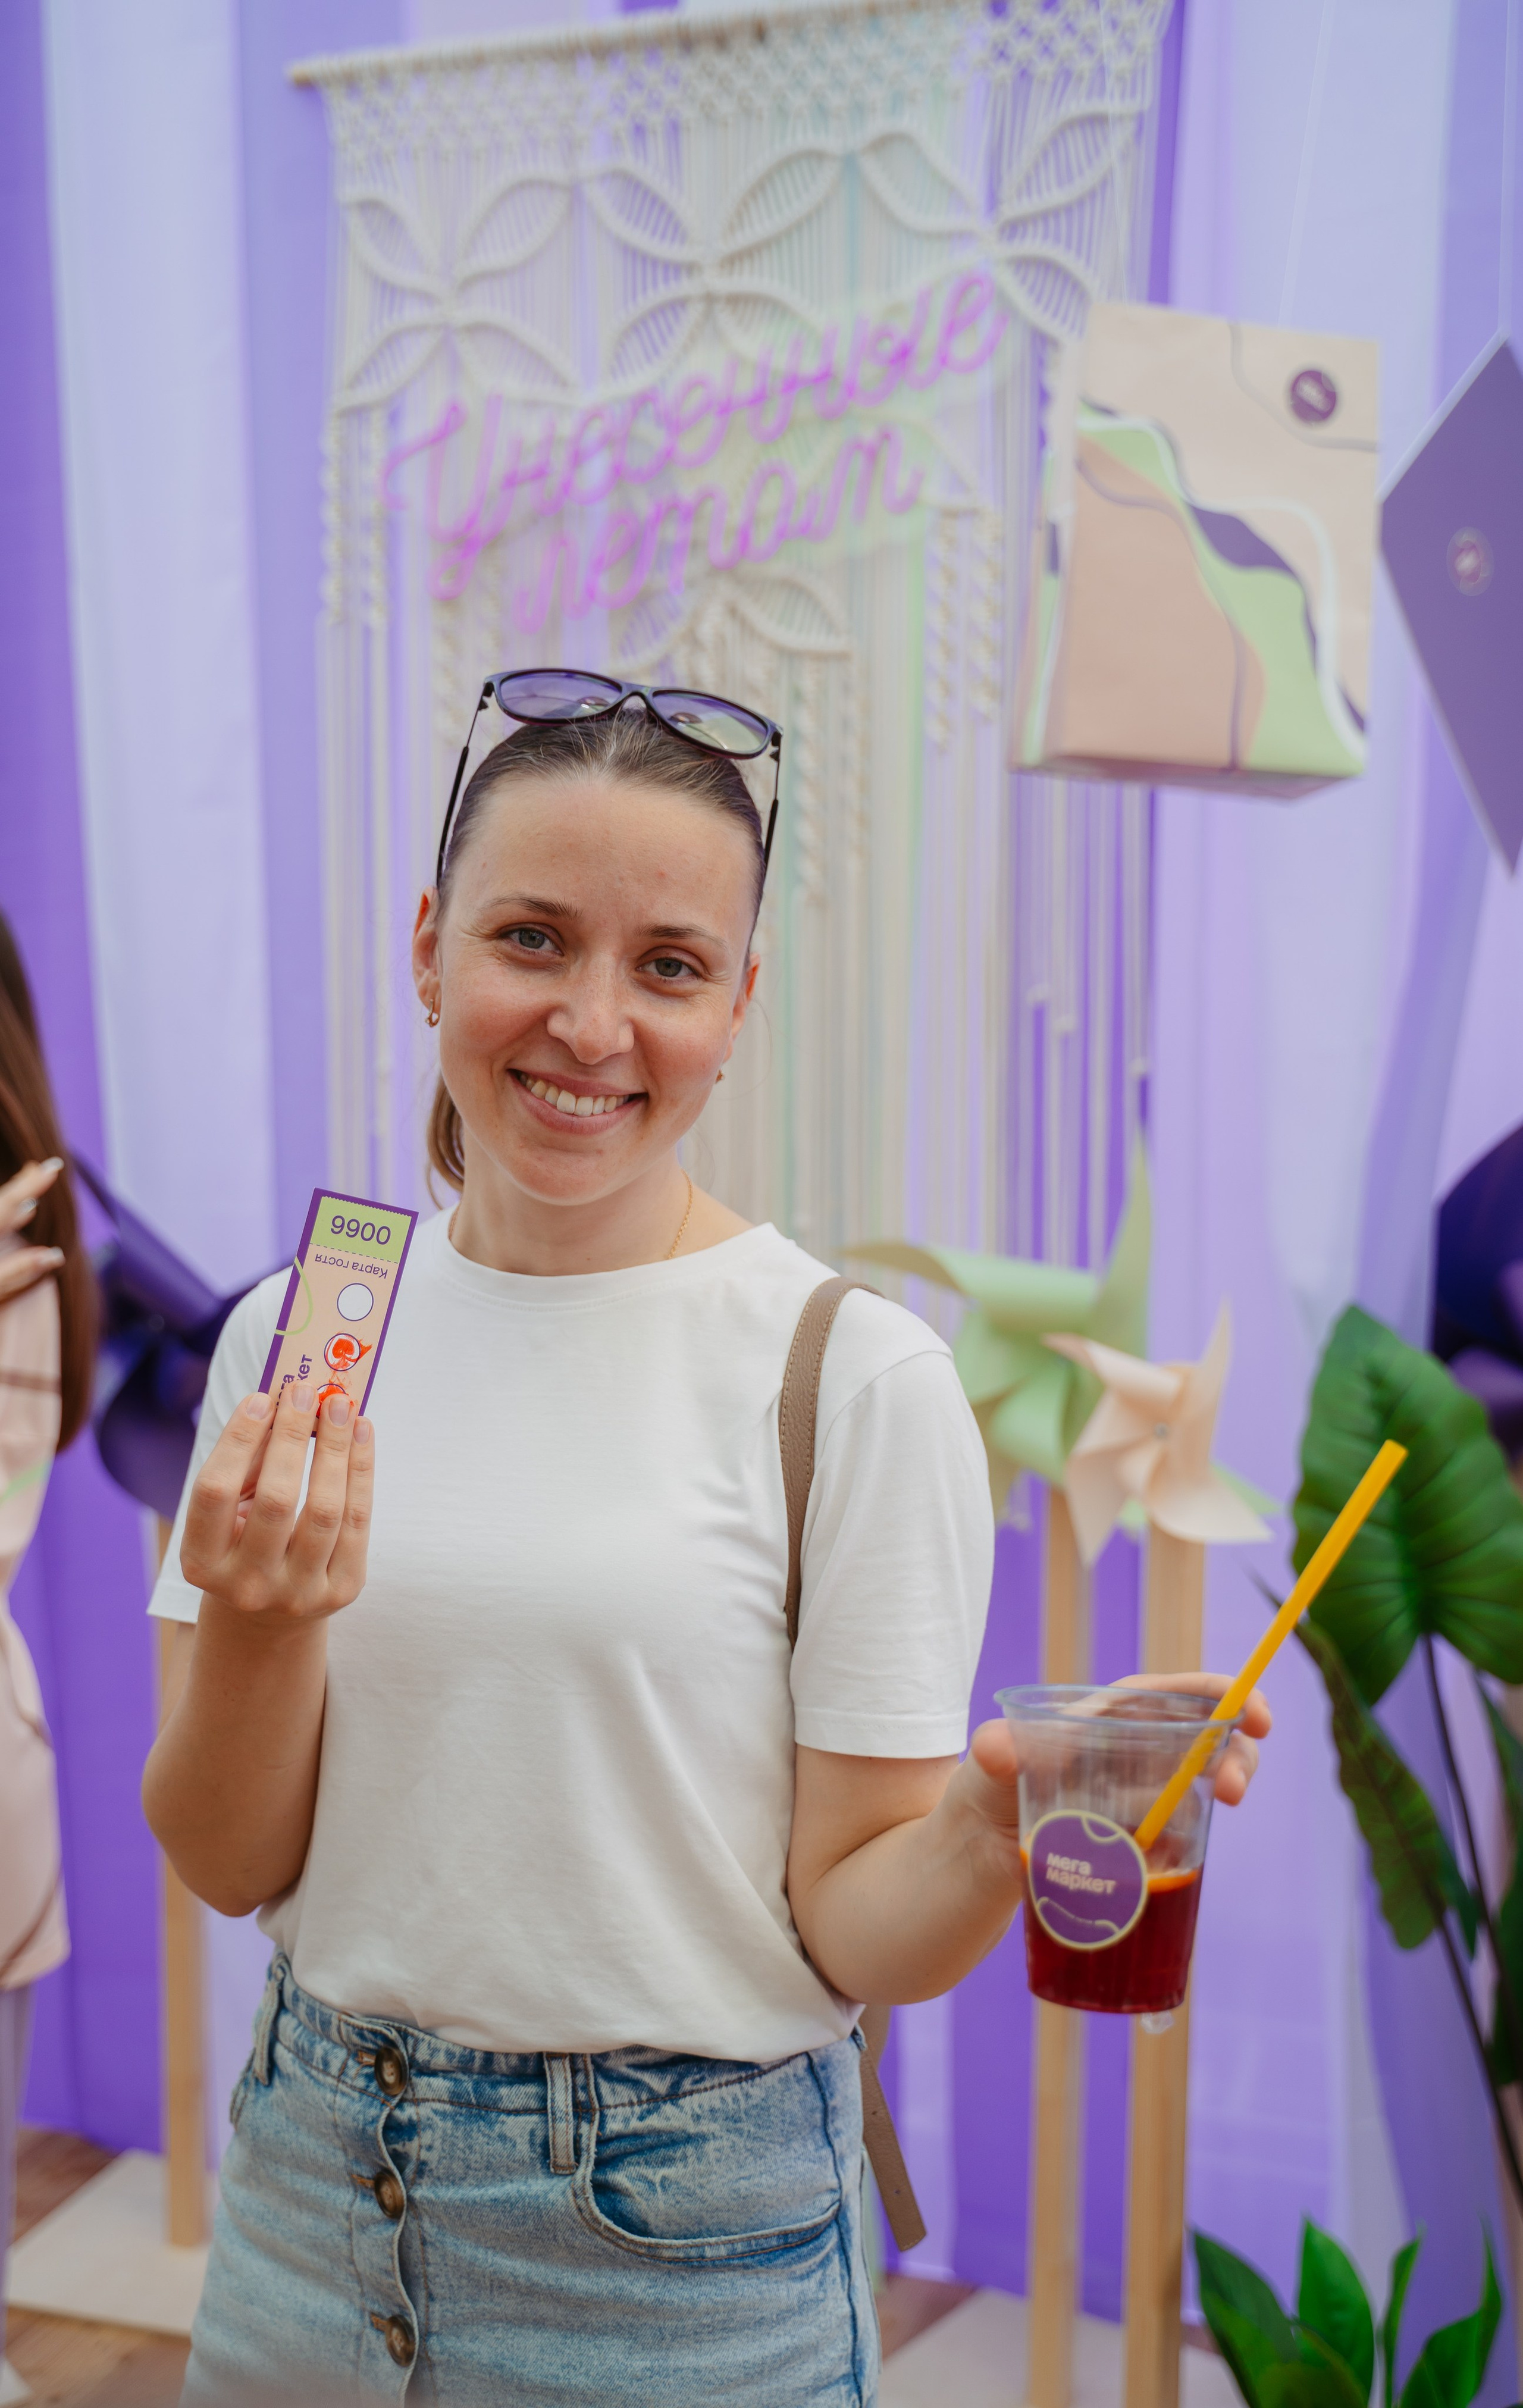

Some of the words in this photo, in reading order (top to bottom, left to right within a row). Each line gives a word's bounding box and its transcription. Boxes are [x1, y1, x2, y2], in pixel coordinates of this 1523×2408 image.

[315, 1253, 350, 1269] гостя
[352, 1261, 388, 1279] Карта
[296, 1354, 313, 1380] кет
[1046, 1852, 1092, 1876] мега
[1045, 1867, 1117, 1895] маркет
